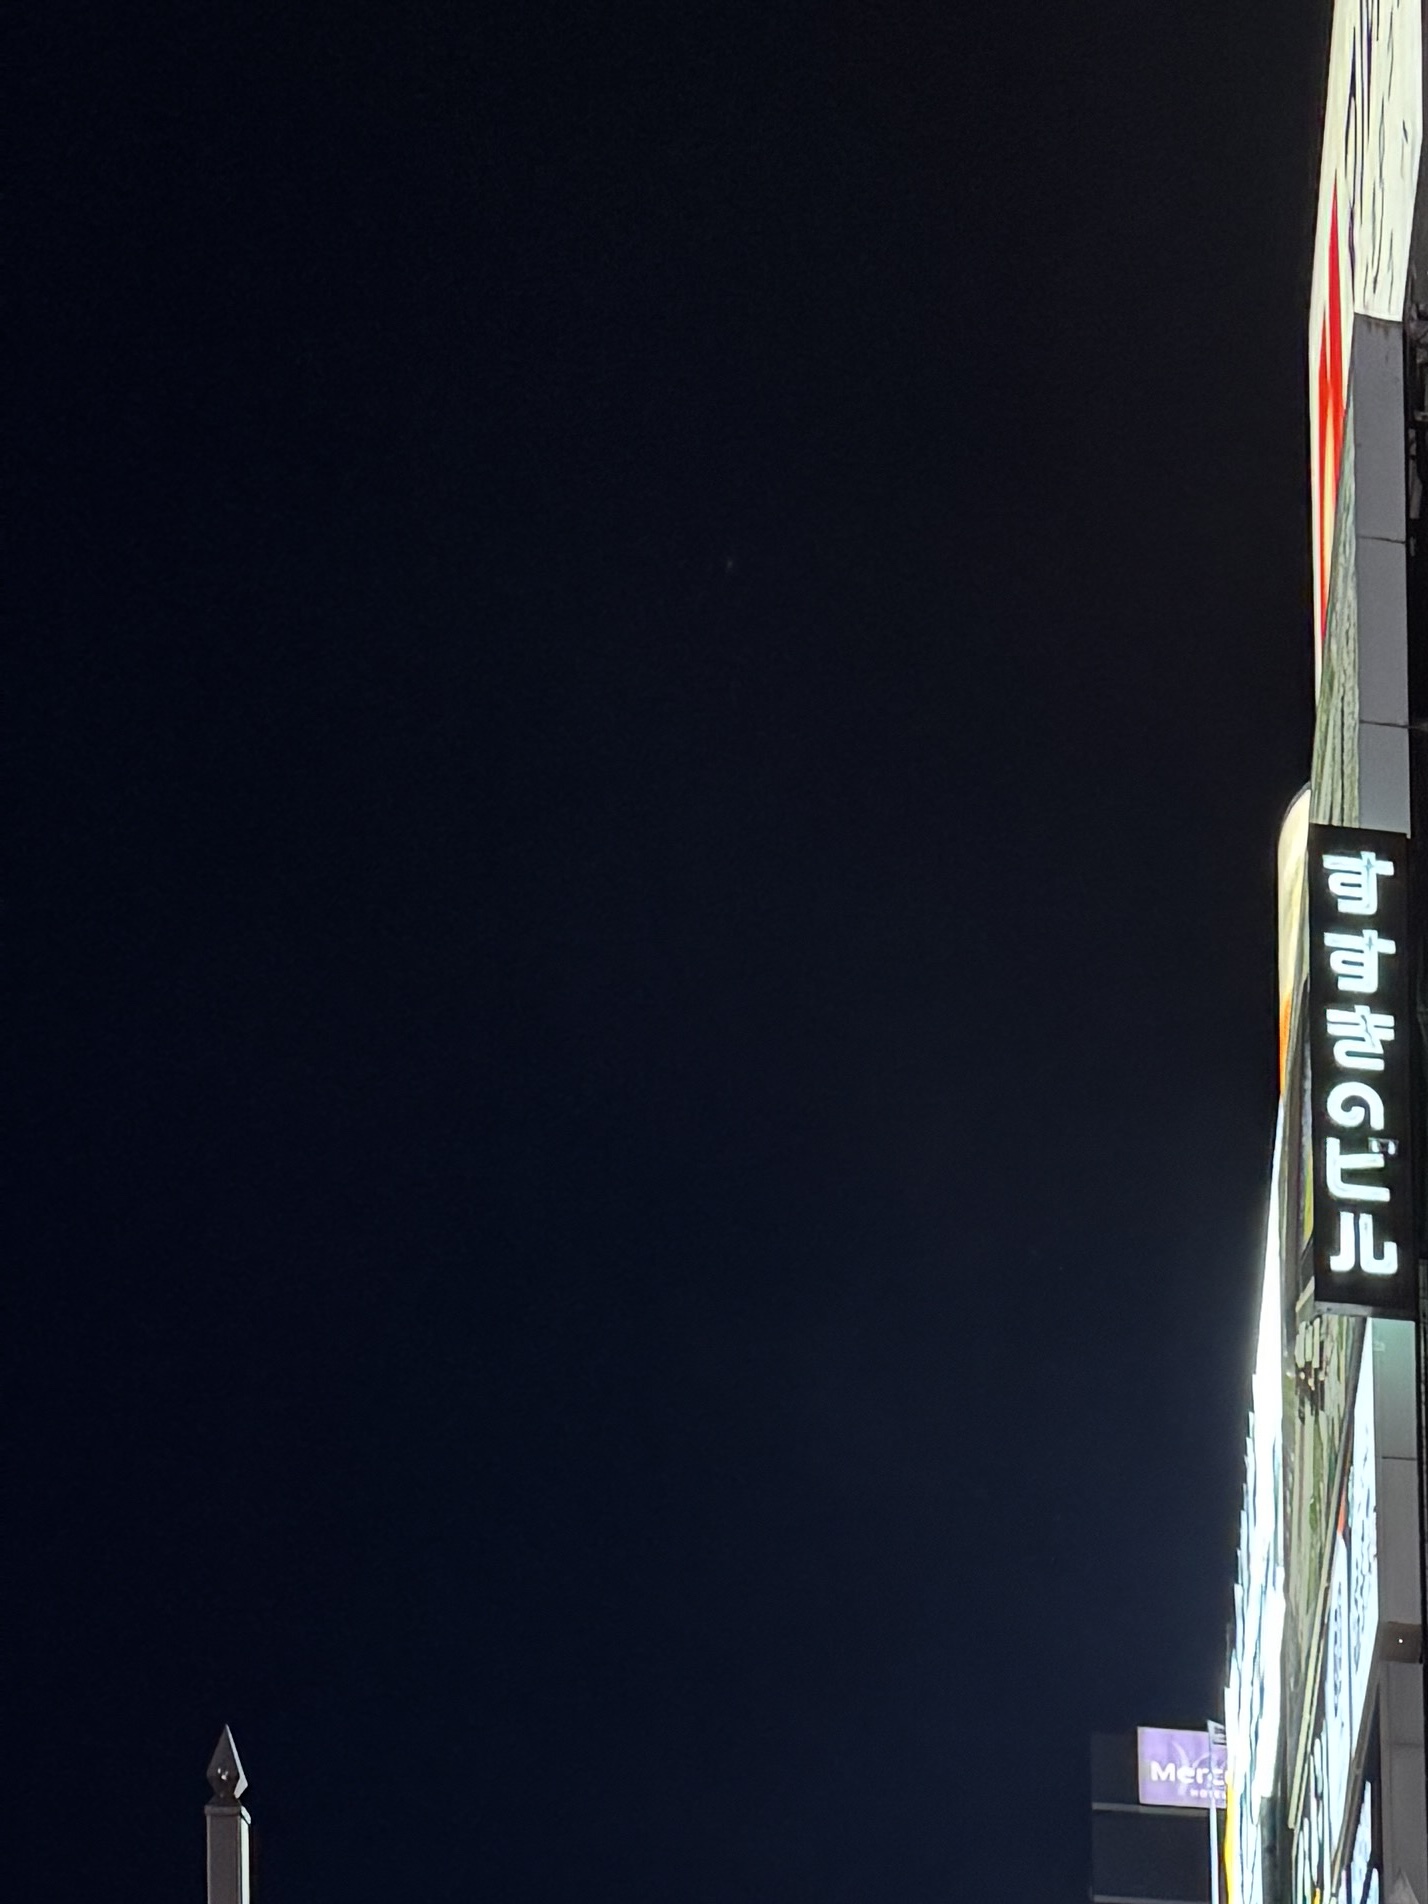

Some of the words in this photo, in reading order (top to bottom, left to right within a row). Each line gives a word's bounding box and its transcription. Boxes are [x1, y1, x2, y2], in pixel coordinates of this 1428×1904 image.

[1322, 850, 1399, 1275] すすきのビル
